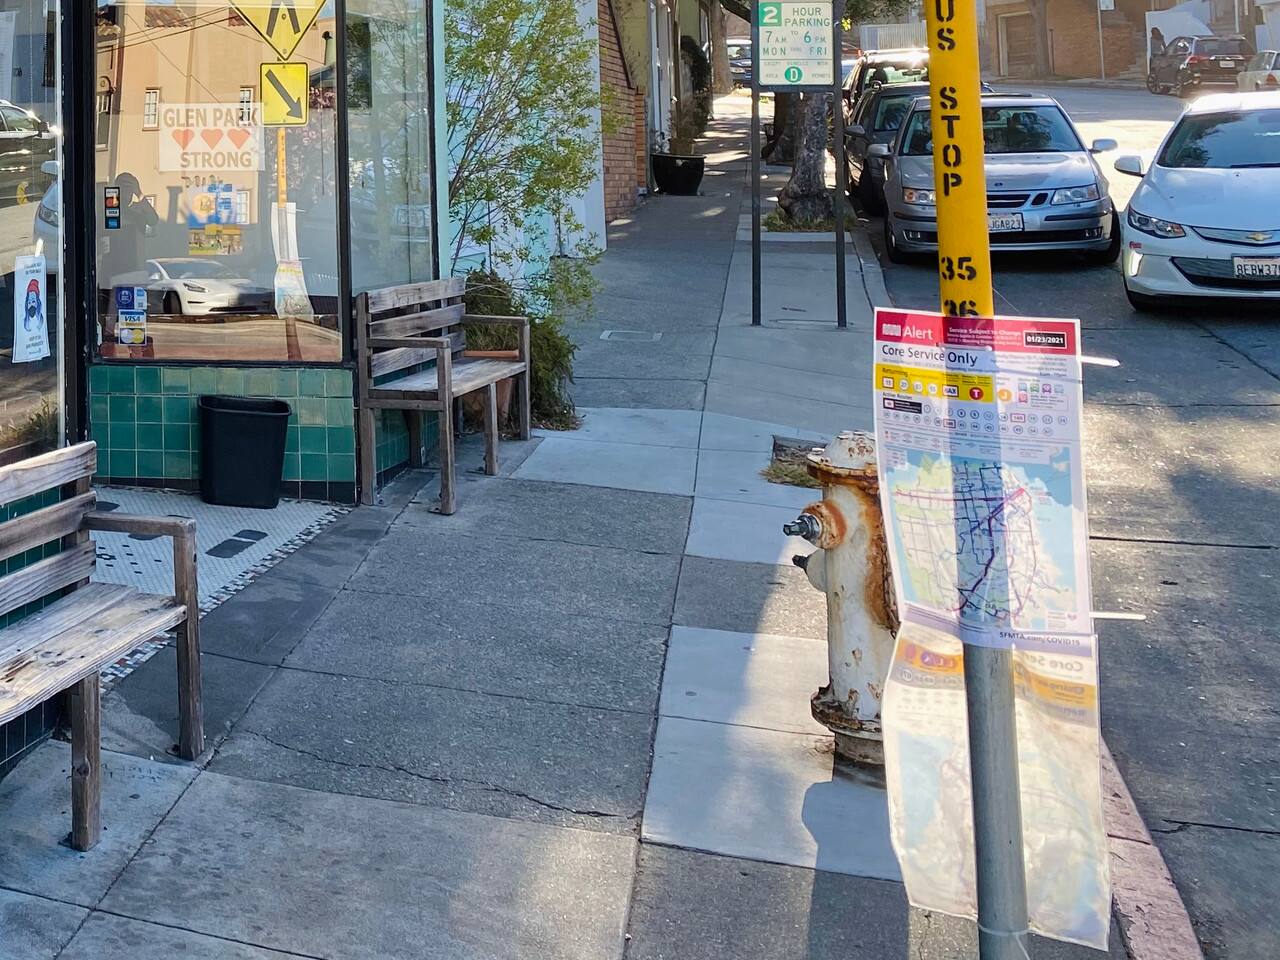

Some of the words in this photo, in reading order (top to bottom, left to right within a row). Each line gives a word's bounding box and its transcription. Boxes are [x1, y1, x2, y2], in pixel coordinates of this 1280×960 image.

[763, 6, 779, 24] 2
[792, 7, 822, 16] HOUR
[784, 18, 831, 27] PARKING
[765, 30, 773, 43] 7
[803, 31, 812, 43] 6
[762, 47, 787, 57] MON
[809, 46, 828, 57] FRI
[790, 68, 799, 81] D
[163, 107, 210, 128] GLEN
[213, 107, 259, 128] PARK
[939, 86, 962, 197] STOP
[180, 151, 252, 169] STRONG
[940, 256, 977, 282] 35
[1236, 264, 1280, 276] 8EBW37
[944, 300, 980, 316] 36
[903, 325, 934, 340] Alert
[1026, 335, 1064, 345] 01/23/2021
[881, 344, 905, 356] Core
[908, 347, 945, 361] Service
[947, 351, 978, 367] Only
